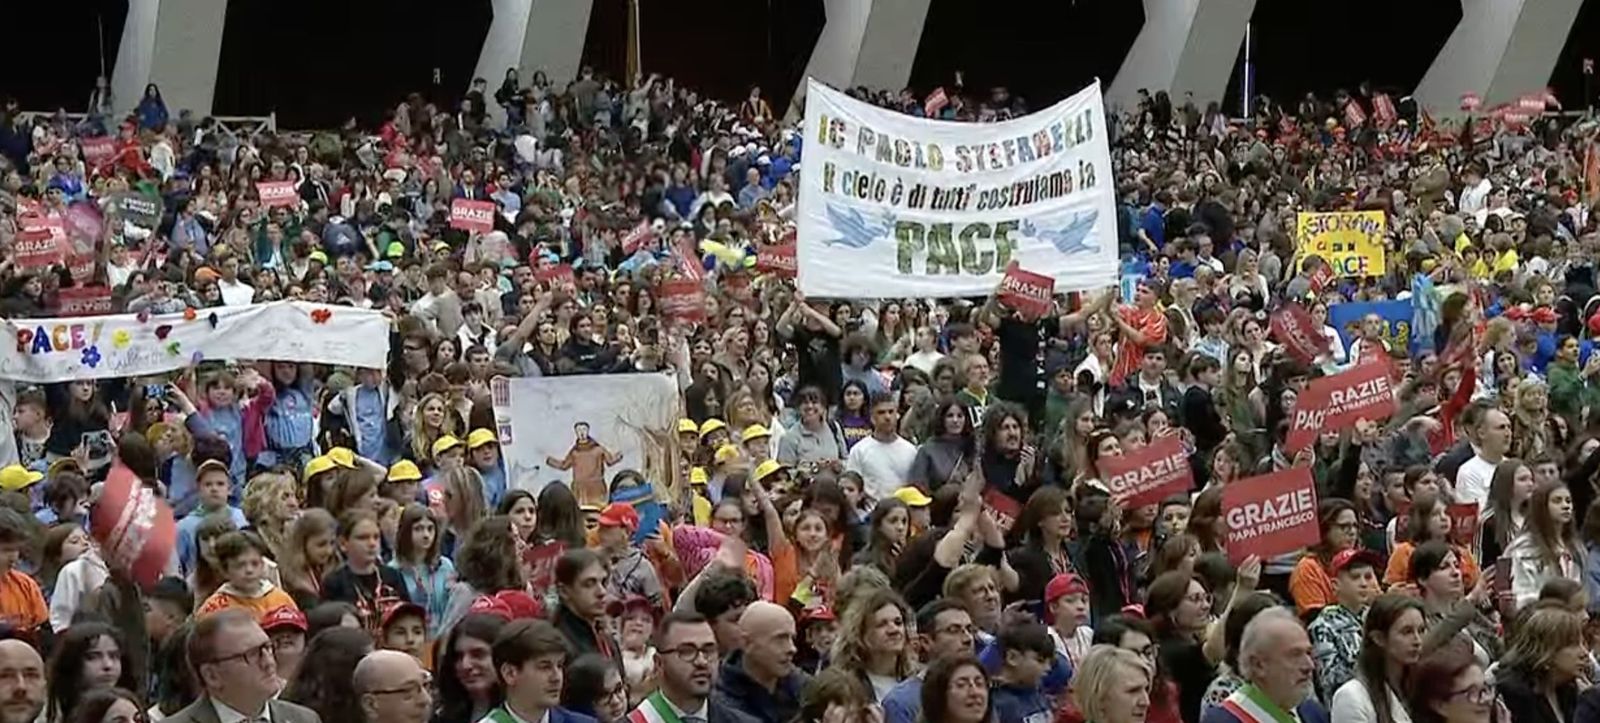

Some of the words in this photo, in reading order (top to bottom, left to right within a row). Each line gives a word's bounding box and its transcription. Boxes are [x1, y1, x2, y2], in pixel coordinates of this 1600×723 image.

[818, 115, 846, 150] IC
[857, 125, 945, 171] PAOLO
[954, 108, 1093, 173] STEFANELLI
[841, 170, 887, 202] cielo
[890, 175, 904, 206] è
[907, 183, 928, 209] di
[976, 168, 1073, 211] costruiamo
[1077, 159, 1096, 191] la
[895, 219, 1020, 275] PACE
[1332, 256, 1369, 276] ACE
[1328, 375, 1389, 406] RAZIE
[1110, 452, 1188, 493] GRAZIE
[1226, 488, 1313, 530] GRAZIE
[1228, 526, 1256, 542] PAPA
[1258, 510, 1314, 535] FRANCESCO
